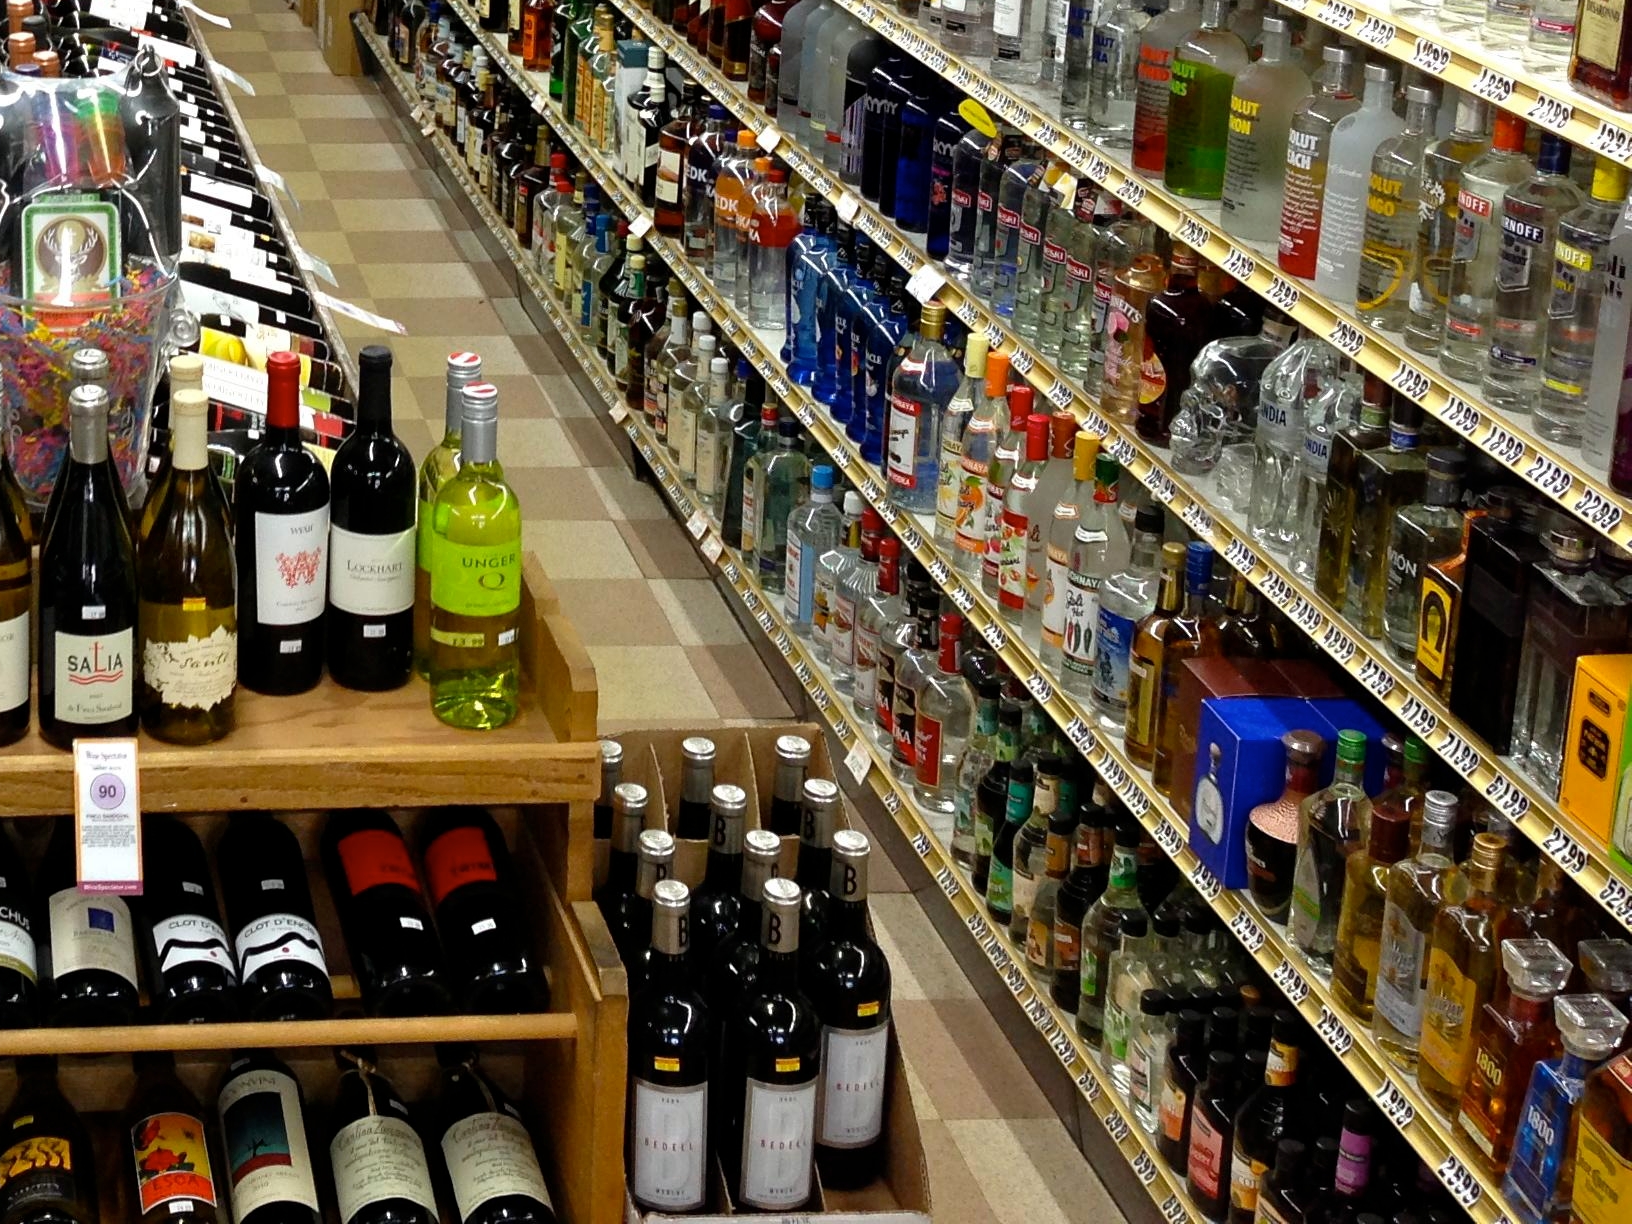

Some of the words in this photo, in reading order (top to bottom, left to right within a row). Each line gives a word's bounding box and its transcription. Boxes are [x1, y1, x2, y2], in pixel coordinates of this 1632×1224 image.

[1440, 396, 1481, 436] 1899
[1481, 425, 1524, 465] 1899
[346, 558, 403, 575] LOCKHART
[461, 554, 516, 571] UNGER
[67, 641, 124, 674] SALIA
[98, 784, 117, 799] 90
[843, 865, 857, 895] B
[678, 914, 689, 947] B
[769, 913, 781, 945] B
[1476, 1047, 1502, 1087] 1800
[1527, 1104, 1555, 1147] 1800
